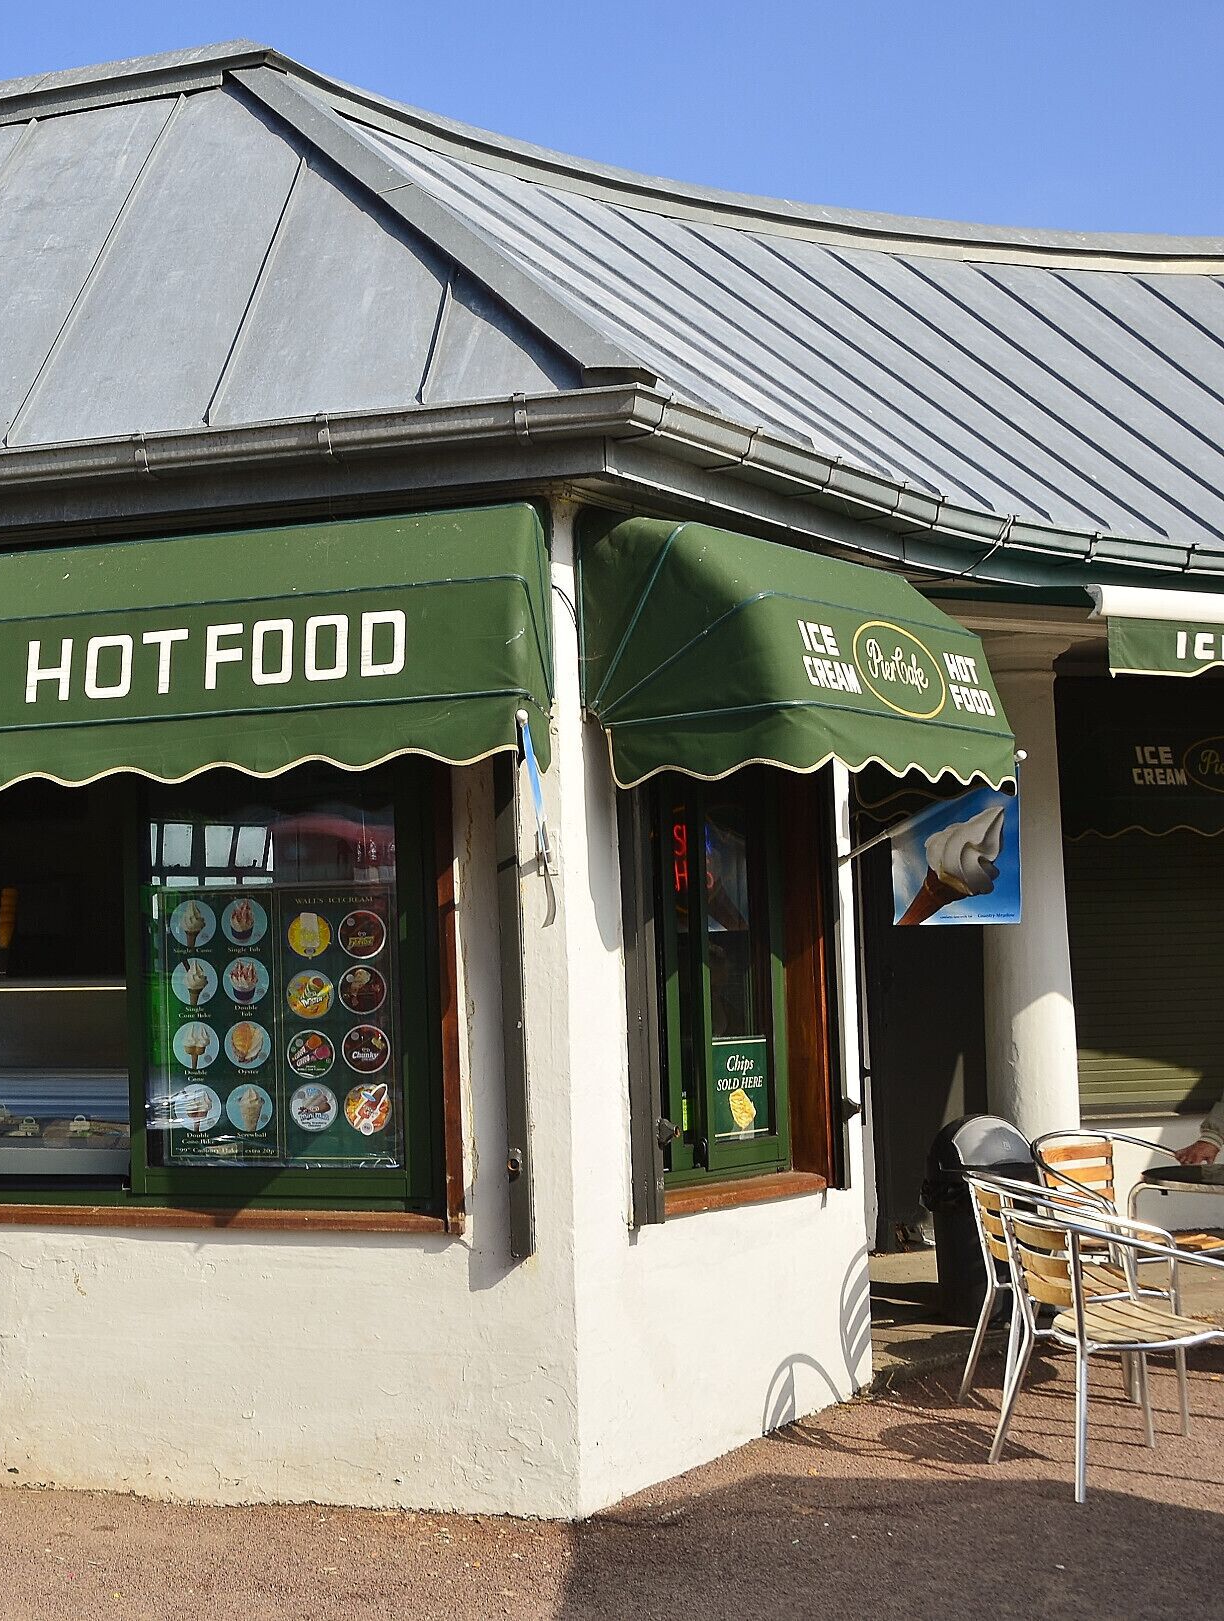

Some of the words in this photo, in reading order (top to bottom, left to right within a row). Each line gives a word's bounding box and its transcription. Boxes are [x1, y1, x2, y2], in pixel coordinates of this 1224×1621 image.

[797, 619, 840, 656] ICE
[1177, 631, 1224, 660] IC
[25, 628, 189, 703] HOT
[205, 609, 406, 690] FOOD
[943, 652, 979, 684] HOT
[803, 655, 862, 694] CREAM
[949, 684, 996, 717] FOOD
[1135, 746, 1173, 764] ICE
[1131, 768, 1187, 785] CREAM
[352, 1051, 379, 1060] Chunky
[726, 1054, 755, 1076] Chips
[716, 1077, 740, 1091] SOLD
[741, 1076, 763, 1090] HERE
